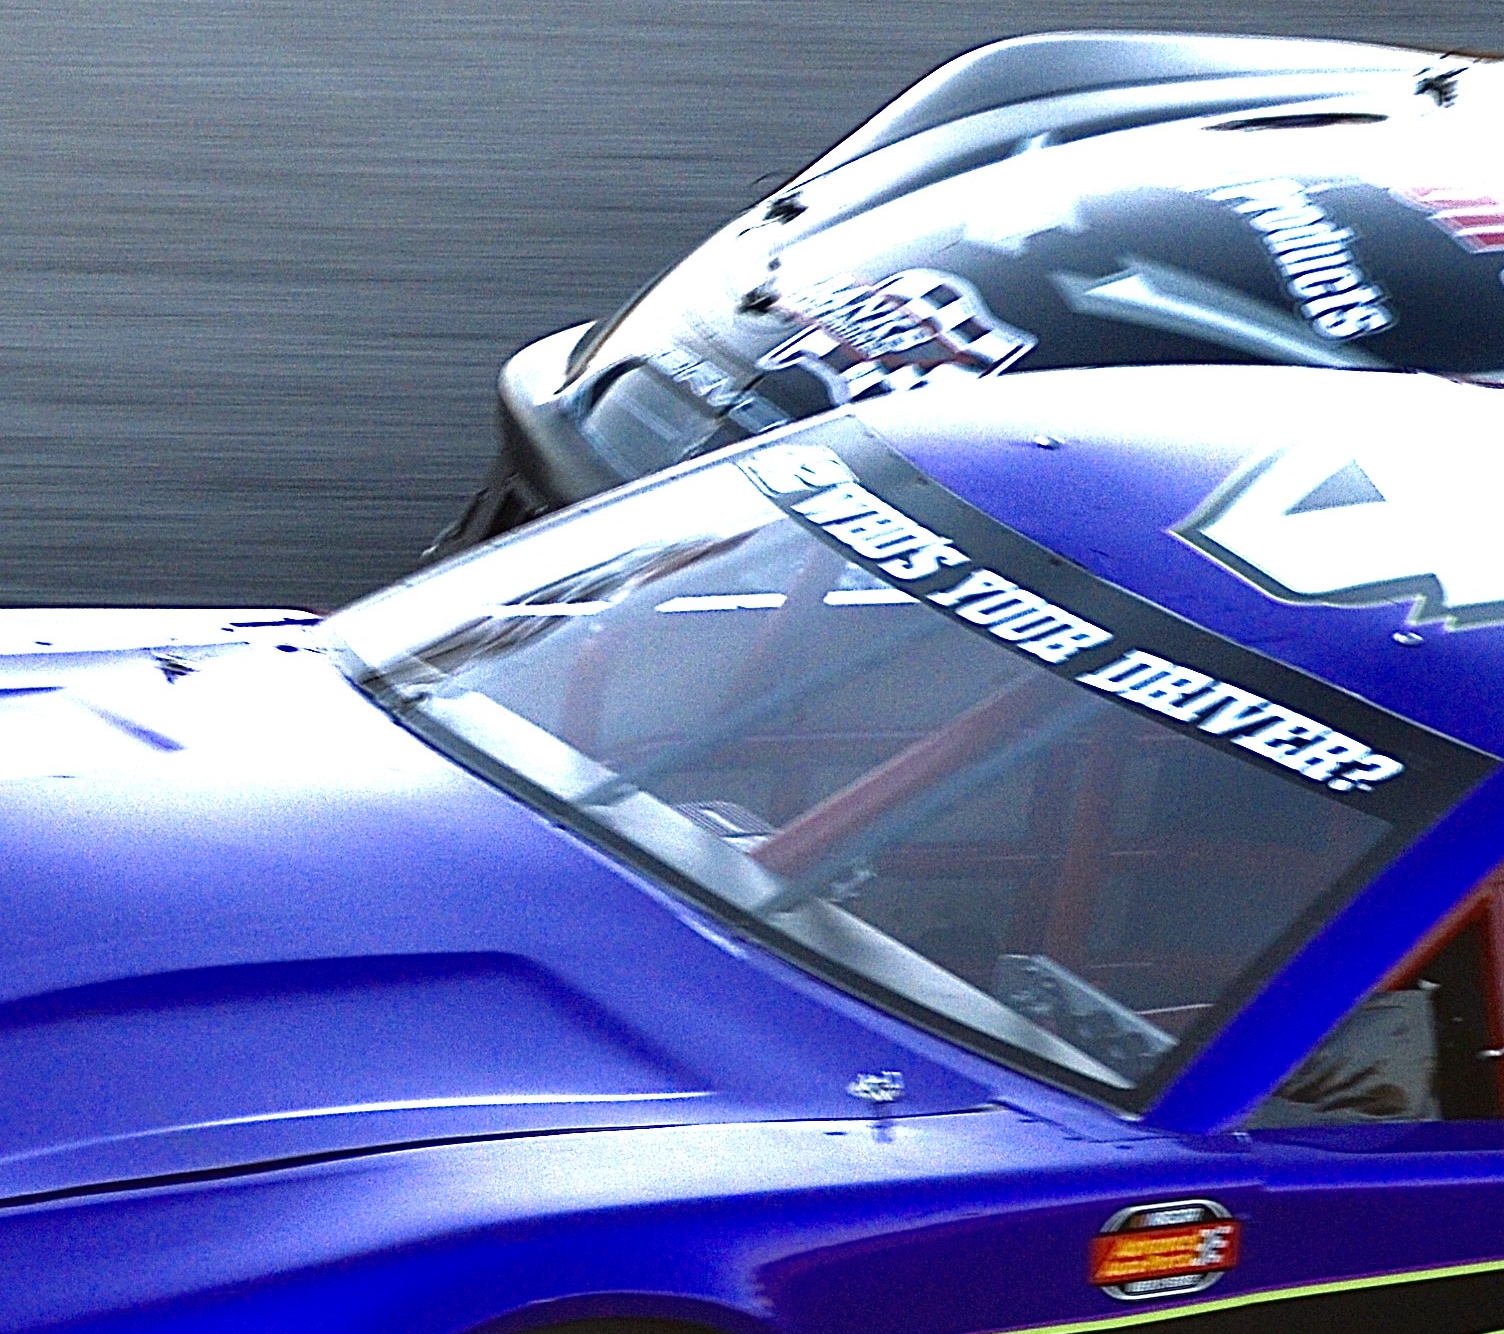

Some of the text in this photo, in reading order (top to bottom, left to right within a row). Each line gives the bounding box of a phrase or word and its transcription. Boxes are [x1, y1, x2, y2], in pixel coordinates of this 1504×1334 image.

[792, 479, 1405, 794] WHO'S YOUR DRIVER?
